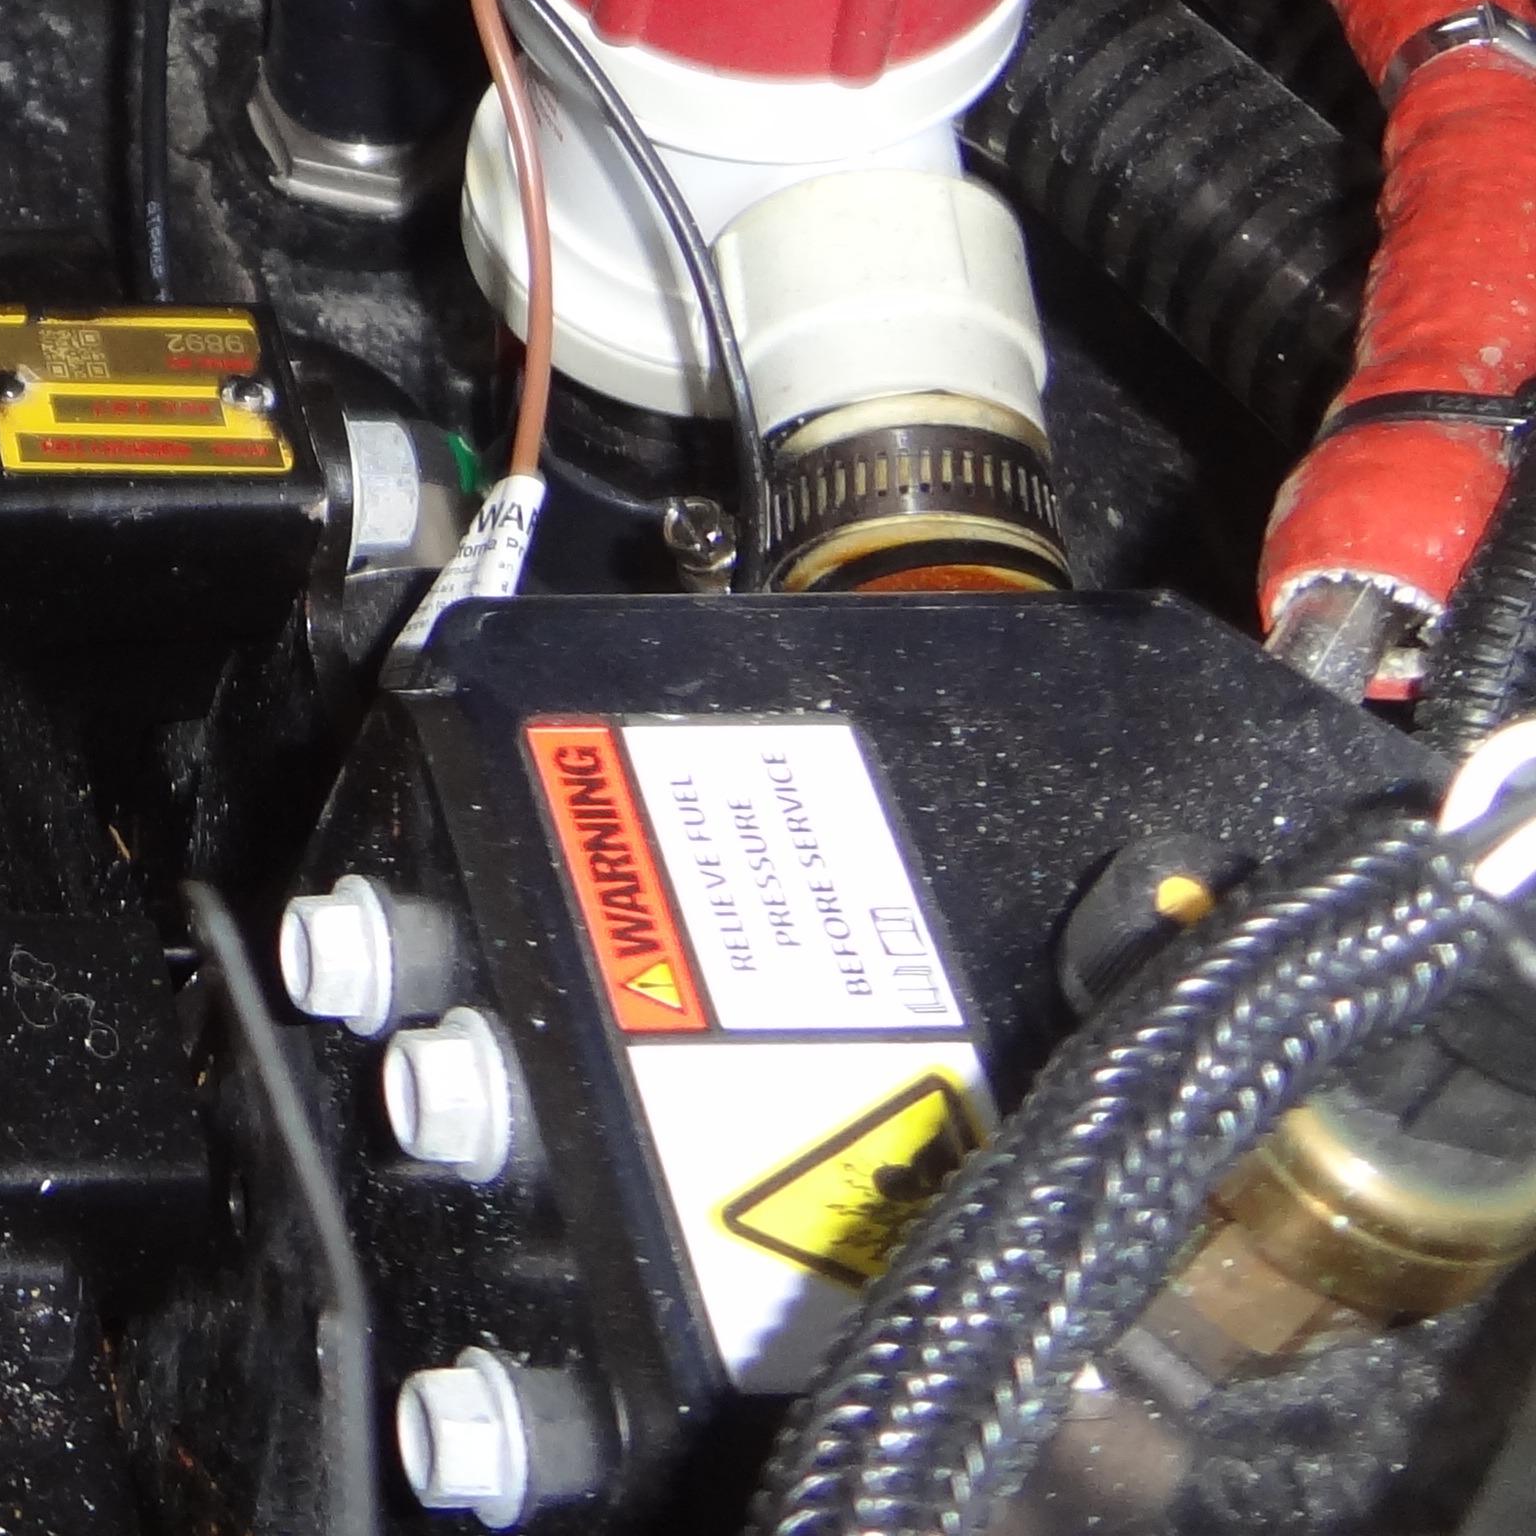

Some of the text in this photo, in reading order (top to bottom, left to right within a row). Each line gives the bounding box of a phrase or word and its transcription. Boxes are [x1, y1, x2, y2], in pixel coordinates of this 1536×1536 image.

[164, 332, 246, 354] 9892
[553, 743, 656, 960] WARNING
[669, 772, 757, 974] RELIEVE FUEL
[726, 794, 801, 950] PRESSURE
[761, 749, 876, 999] BEFORE SERVICE
